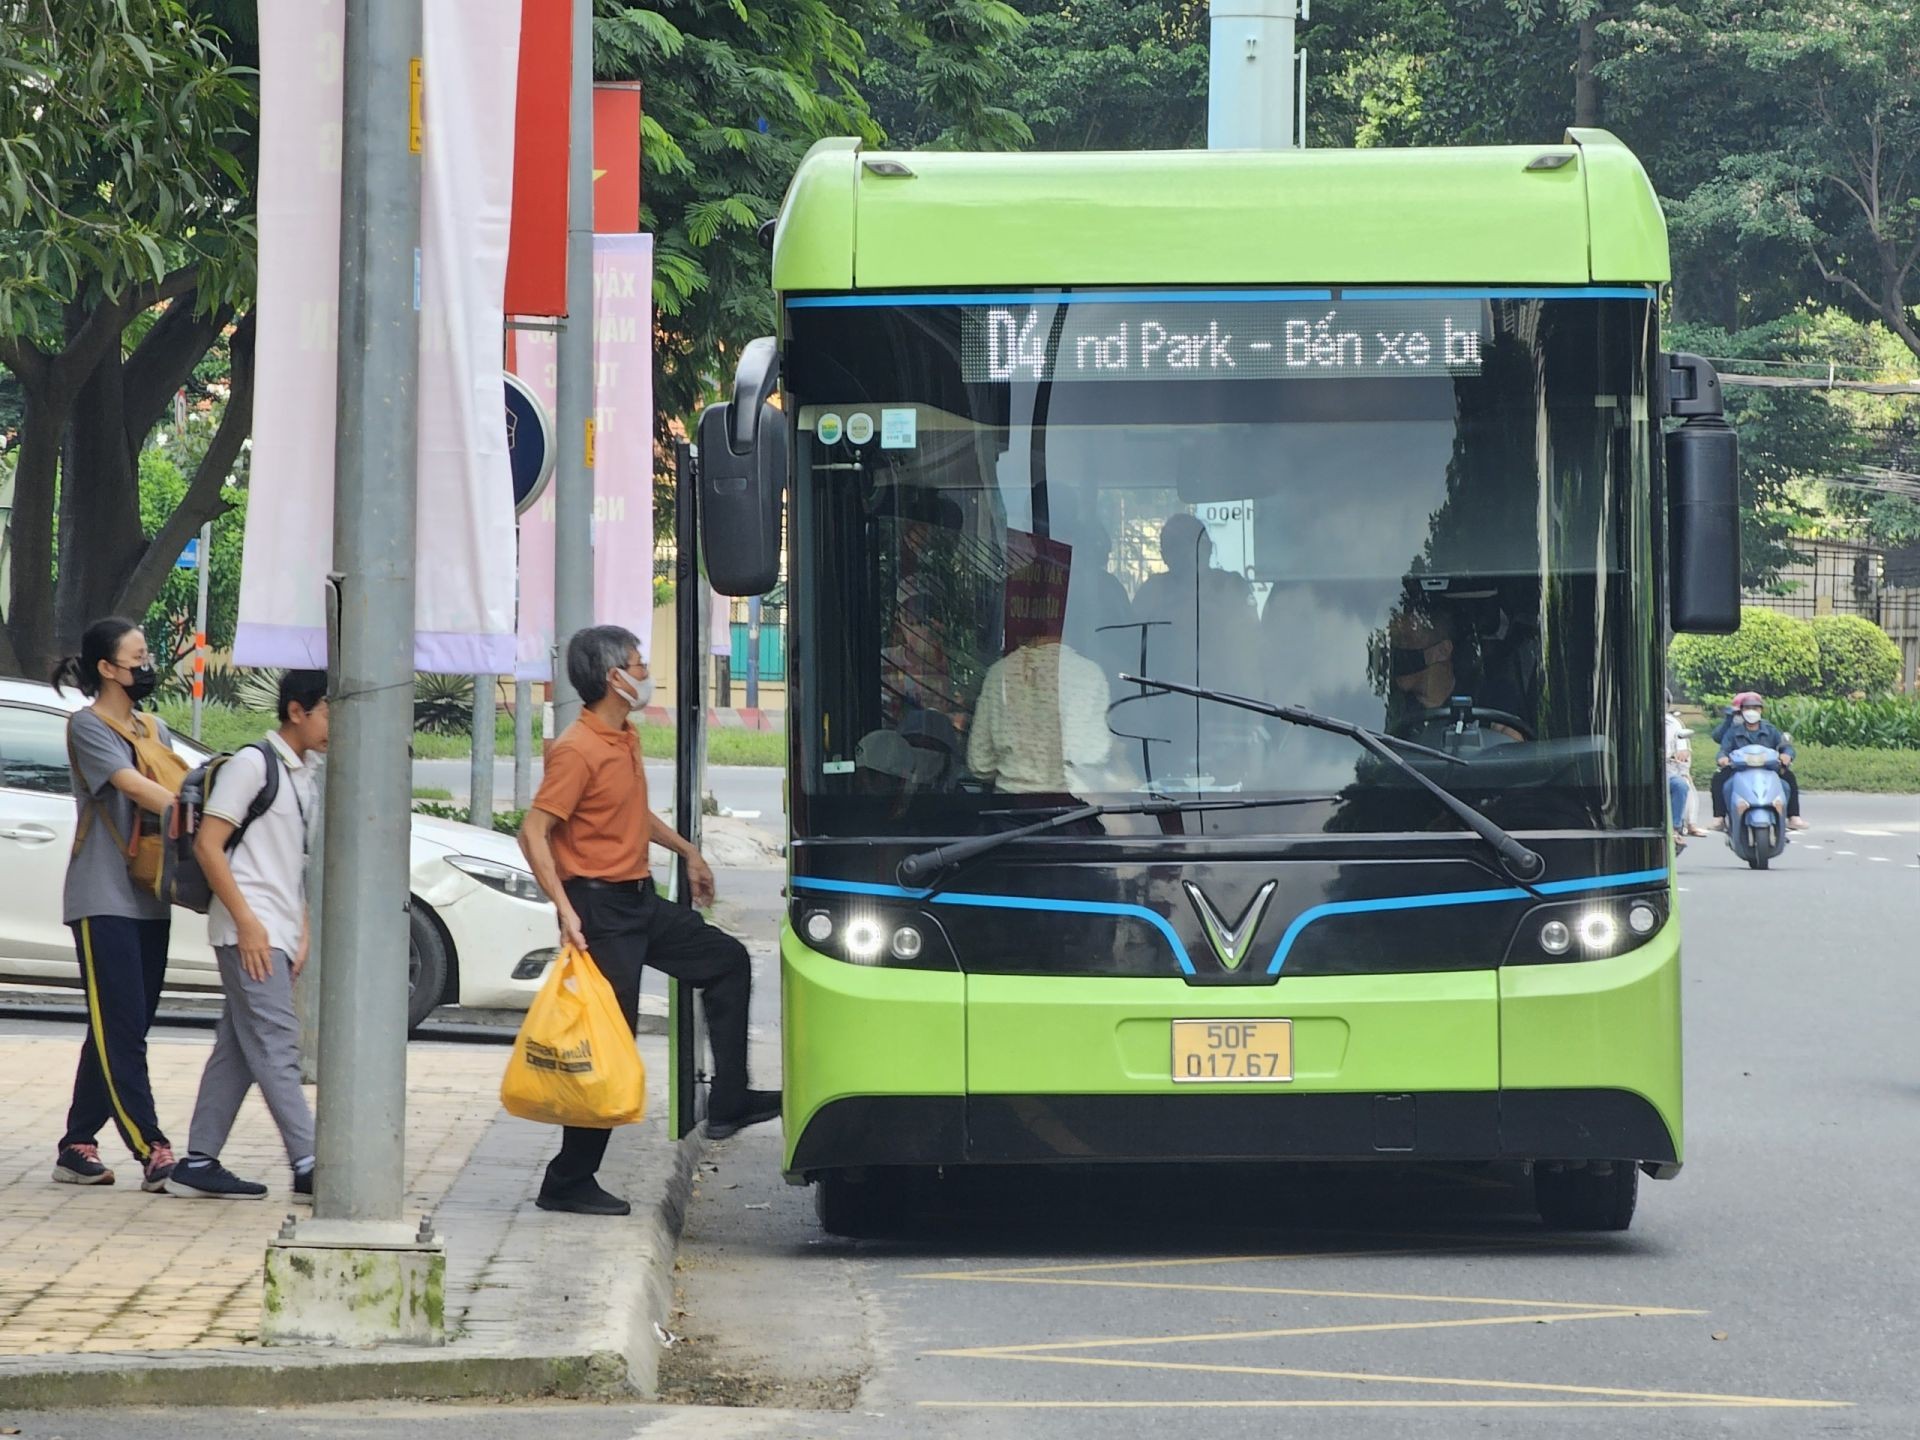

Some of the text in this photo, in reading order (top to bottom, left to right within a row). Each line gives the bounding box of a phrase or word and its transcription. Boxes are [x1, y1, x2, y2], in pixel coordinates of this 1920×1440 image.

[988, 310, 1046, 378] D4
[1076, 321, 1127, 368] nd
[1141, 320, 1236, 368] Park
[1286, 310, 1362, 367] Bến
[1376, 331, 1431, 365] xe
[1207, 1025, 1257, 1049] 50F
[1187, 1053, 1279, 1077] 017.67
